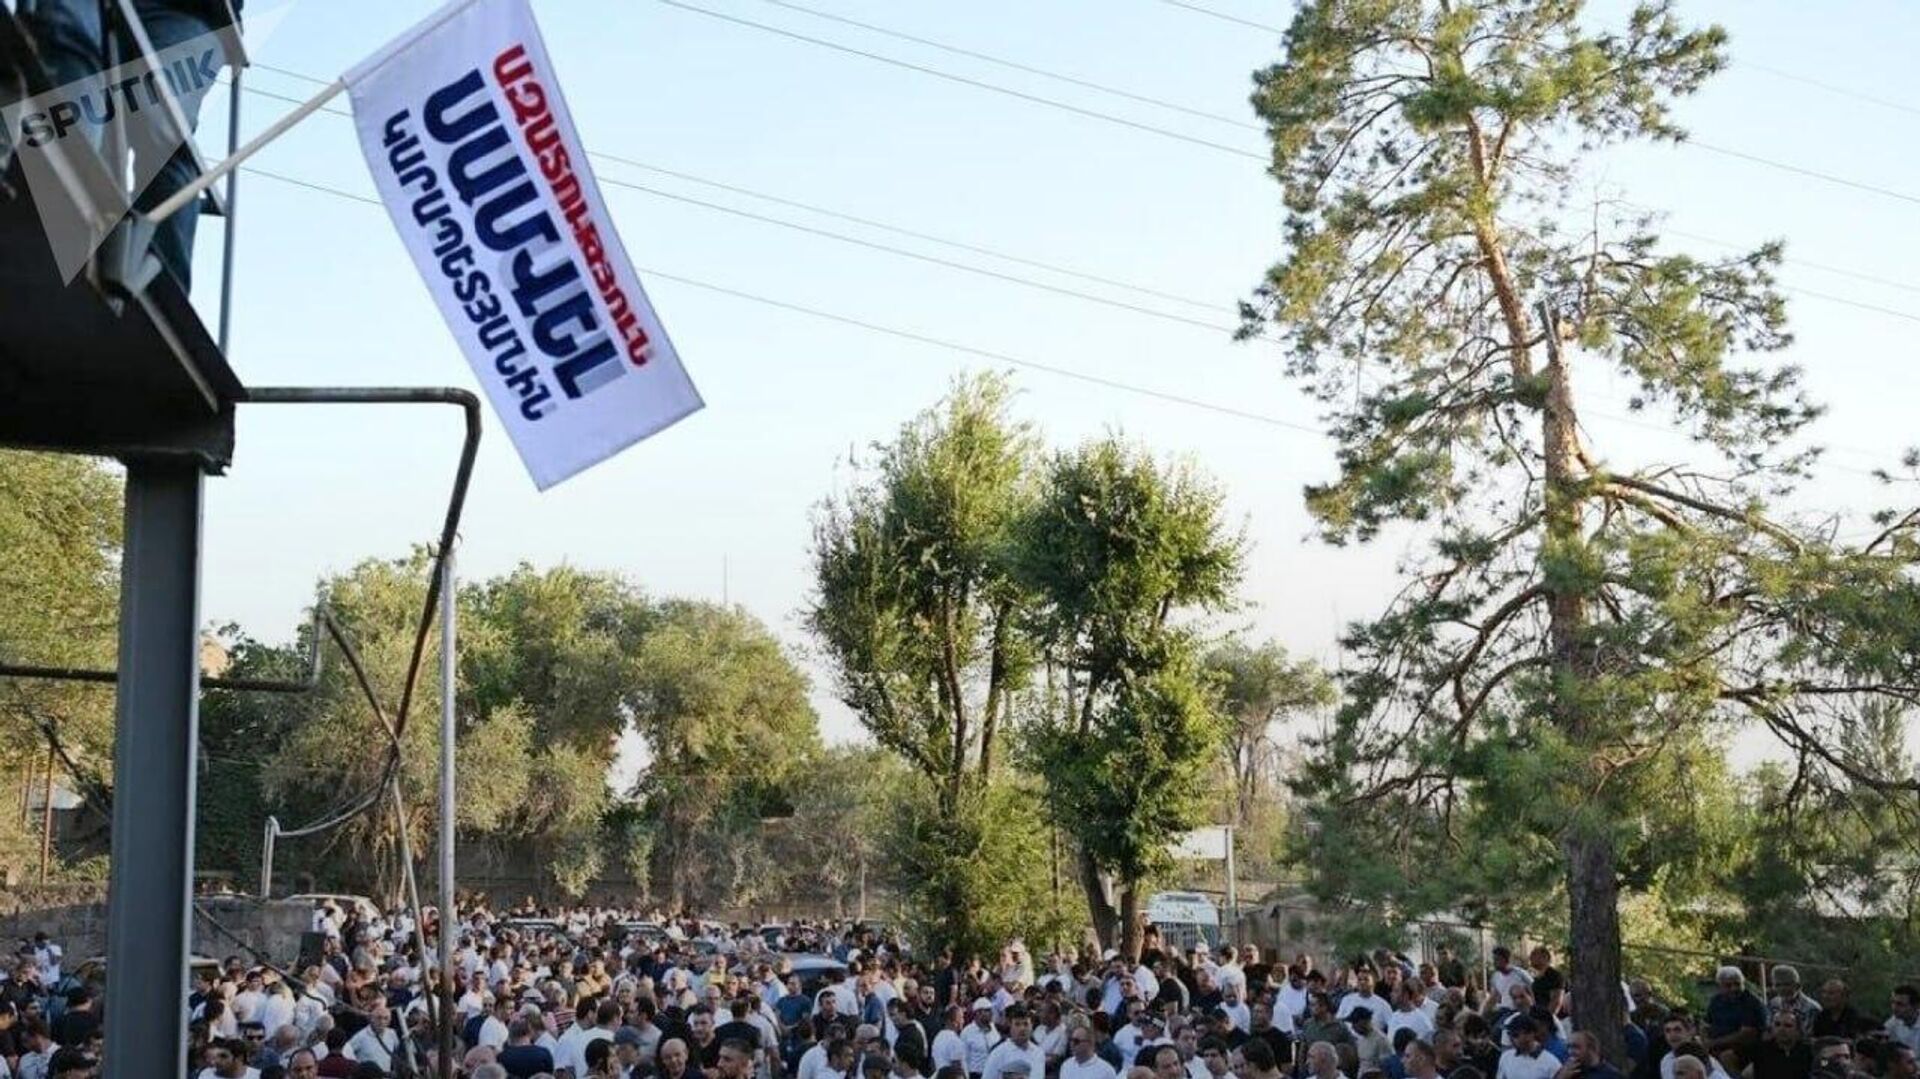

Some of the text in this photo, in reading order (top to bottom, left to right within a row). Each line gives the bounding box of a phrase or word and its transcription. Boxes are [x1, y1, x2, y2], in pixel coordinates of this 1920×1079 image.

[383, 108, 555, 421] ԿԱՐԱՊԵՏՅԱՆԻՆ
[423, 69, 622, 400] ՍԱՄՎԵԼ
[492, 44, 651, 368] ԱԶԱՏՈՒԹՅՈՒՆ
